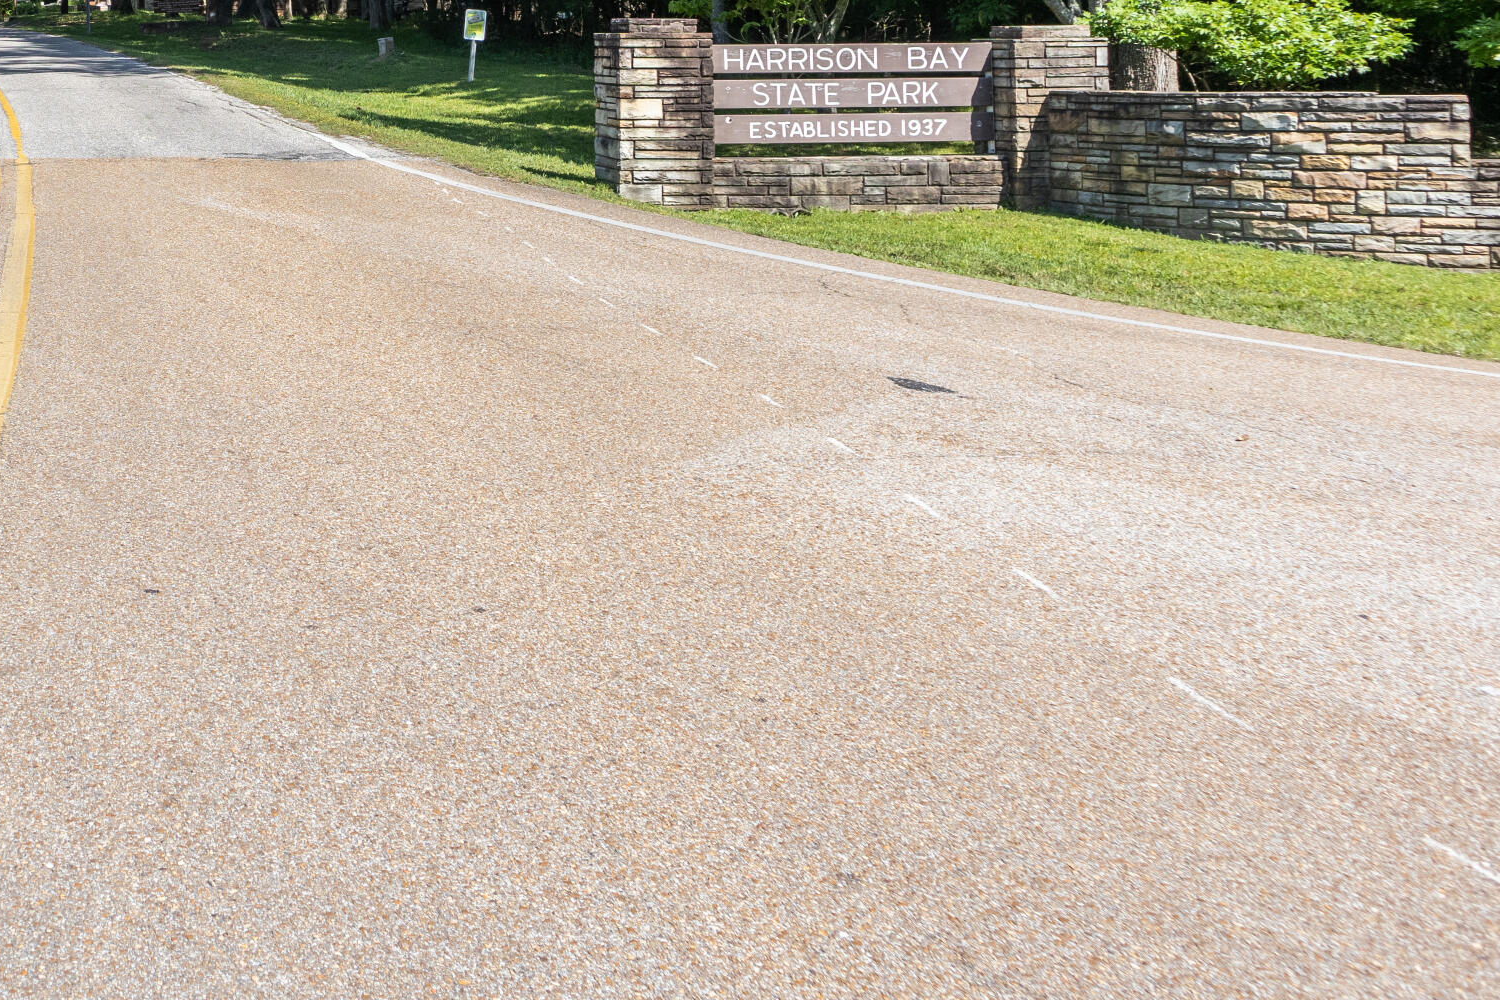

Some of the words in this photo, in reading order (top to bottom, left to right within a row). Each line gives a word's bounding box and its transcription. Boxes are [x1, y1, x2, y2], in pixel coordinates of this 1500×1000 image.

[723, 47, 878, 70] HARRISON
[907, 46, 969, 69] BAY
[752, 82, 840, 105] STATE
[867, 81, 939, 104] PARK
[749, 120, 891, 139] ESTABLISHED
[900, 118, 947, 136] 1937
